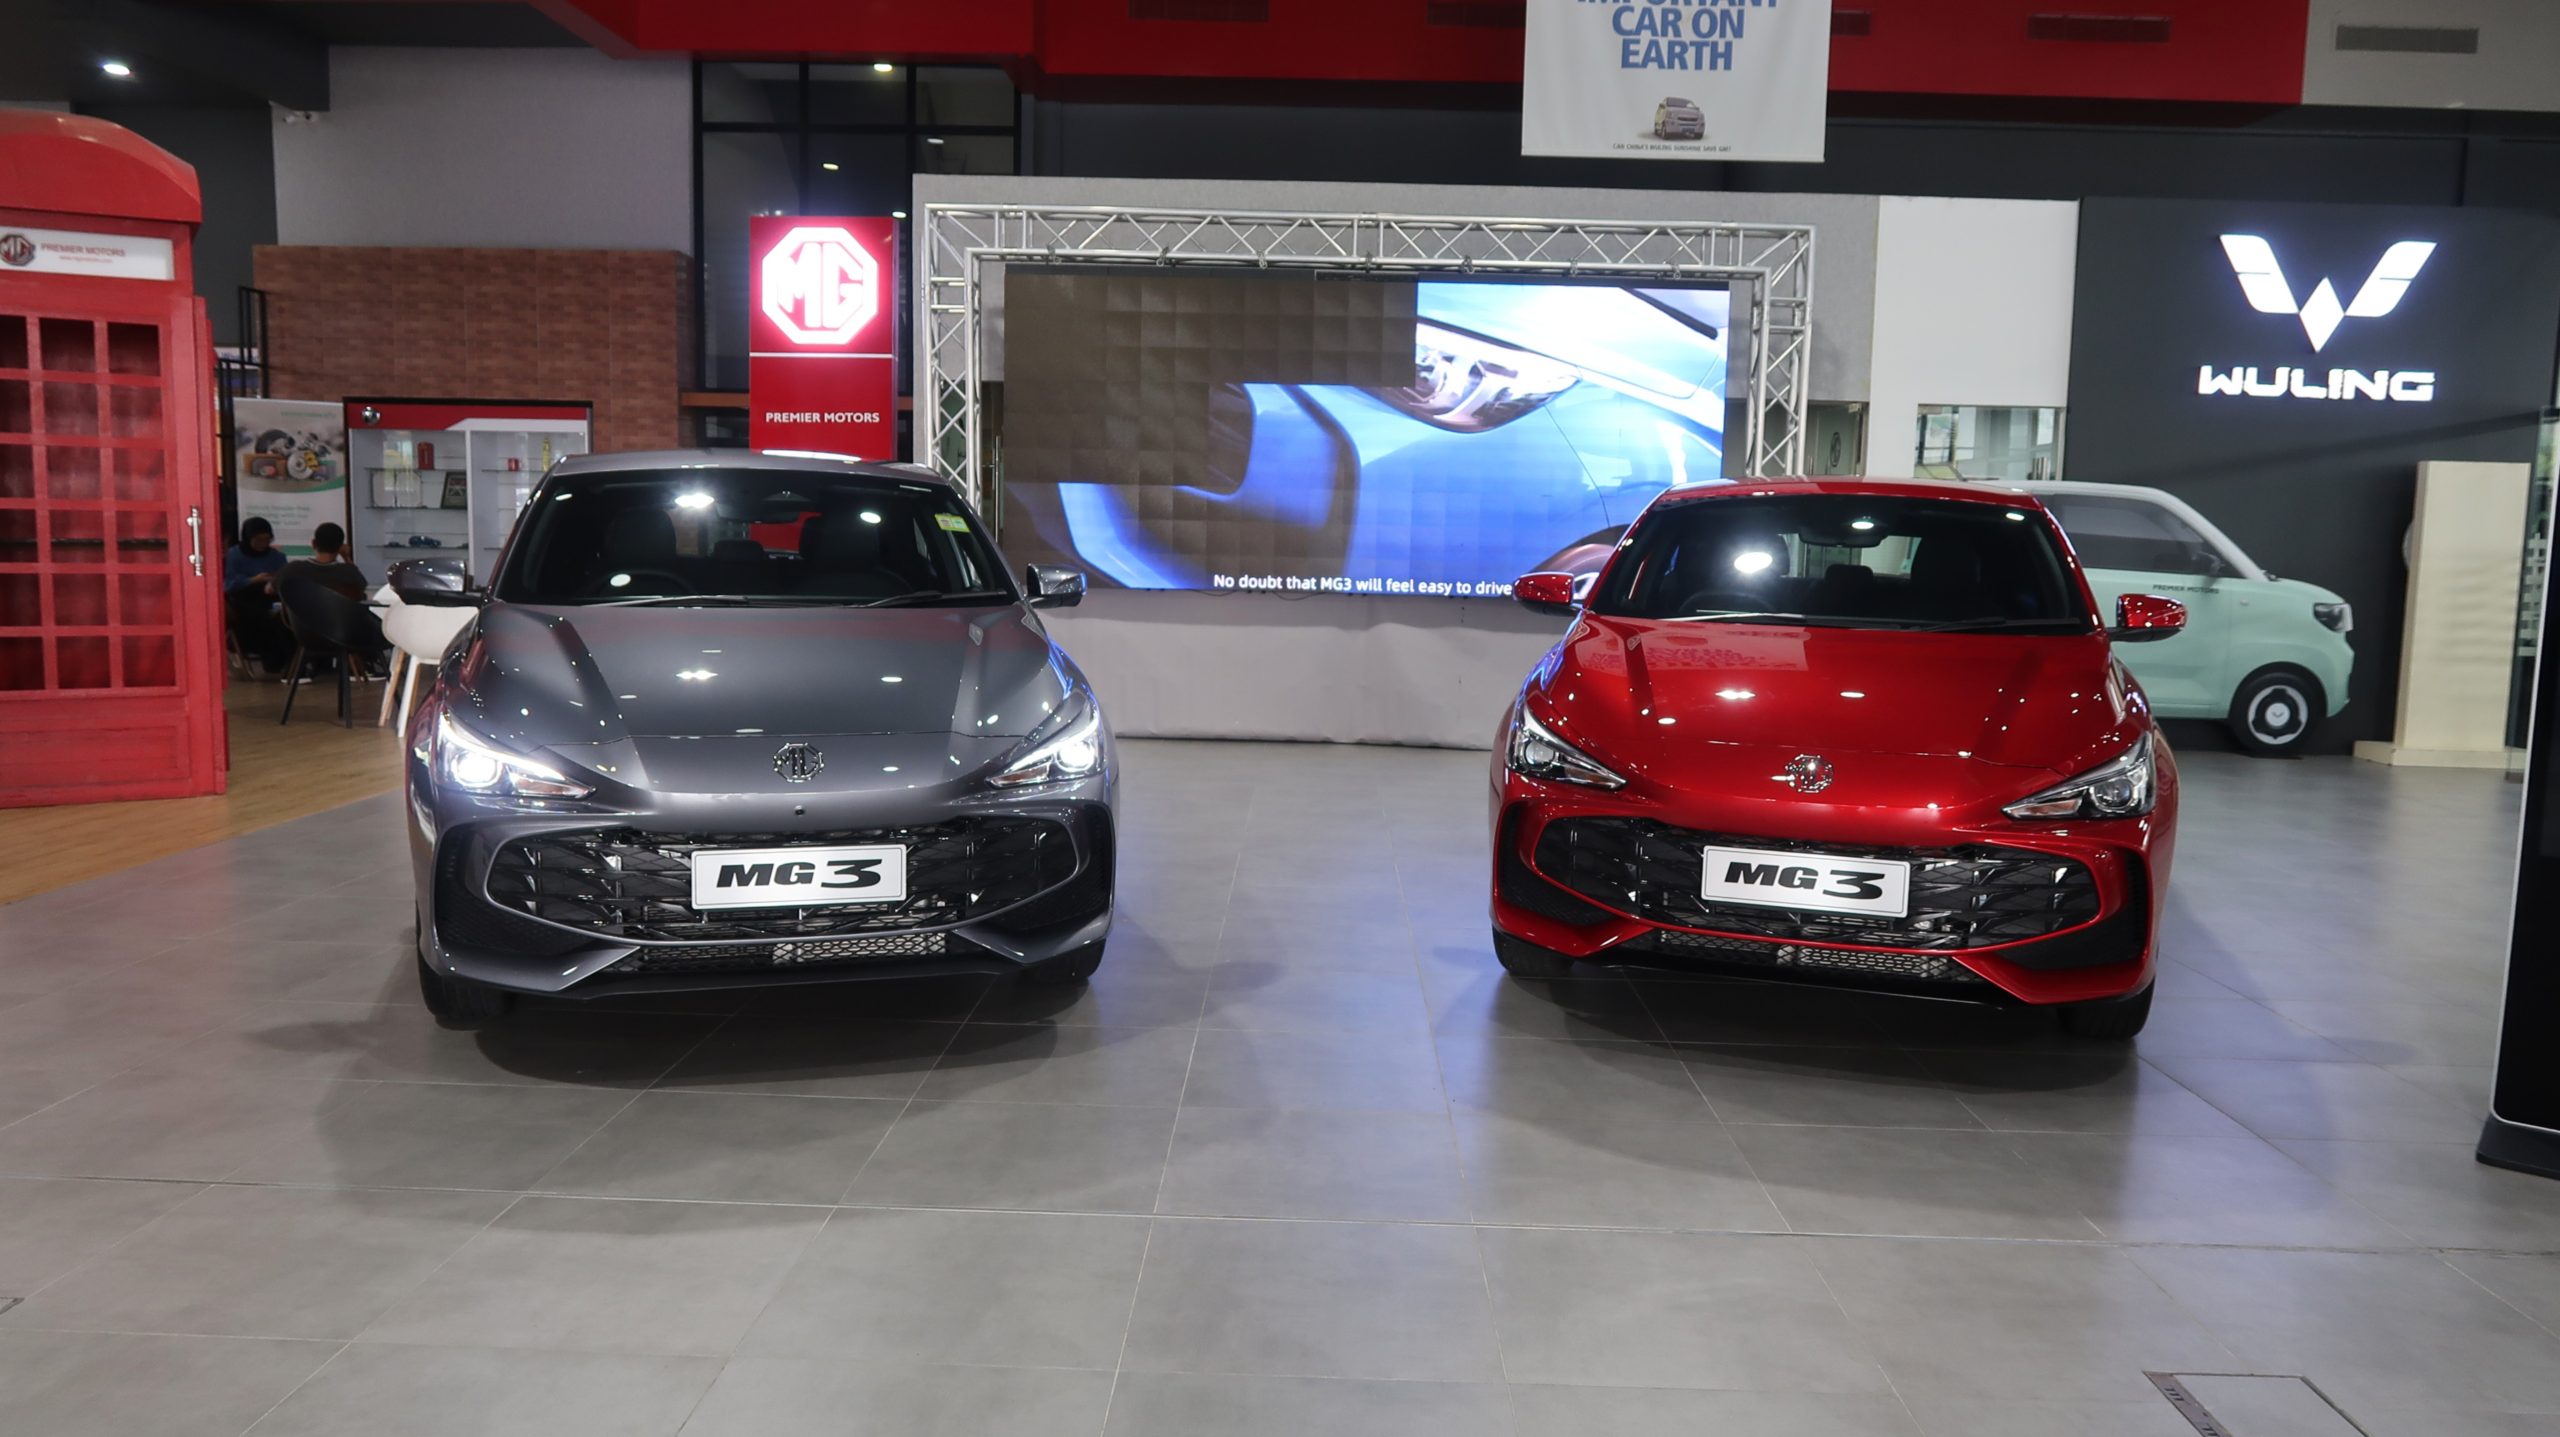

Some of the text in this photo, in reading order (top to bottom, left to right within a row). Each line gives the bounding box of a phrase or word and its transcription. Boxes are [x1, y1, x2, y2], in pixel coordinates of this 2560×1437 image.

[1612, 5, 1745, 39] CAR ON
[1621, 38, 1733, 71] EARTH
[40, 242, 85, 255] PREMIER
[86, 246, 126, 258] MOTORS
[768, 232, 872, 339] MG
[2198, 365, 2436, 402] WULING
[765, 411, 880, 424] PREMIER MOTORS
[1213, 574, 1512, 596] No doubt that MG3 will feel easy to drive
[2152, 584, 2219, 594] PREMIER MOTORS
